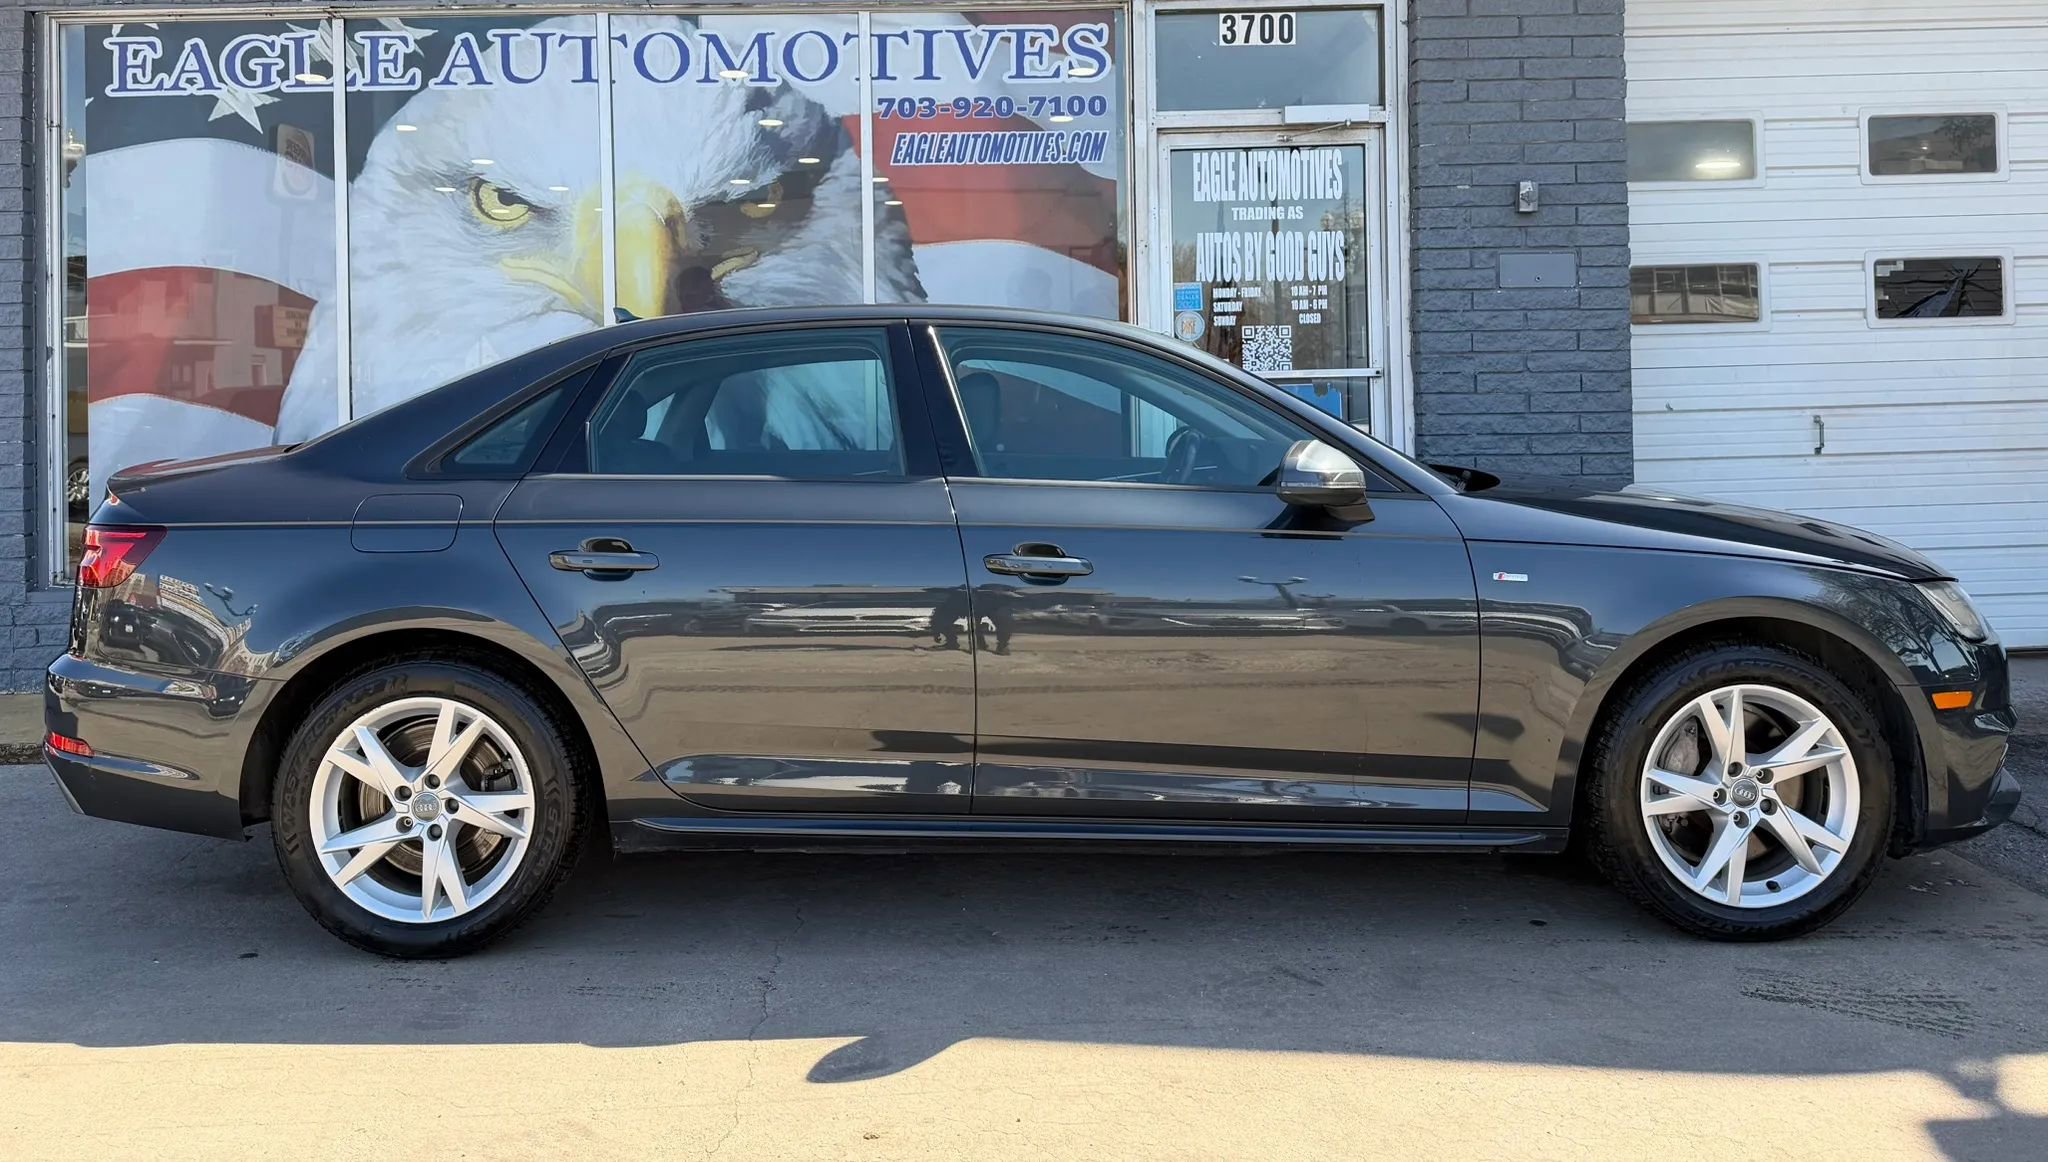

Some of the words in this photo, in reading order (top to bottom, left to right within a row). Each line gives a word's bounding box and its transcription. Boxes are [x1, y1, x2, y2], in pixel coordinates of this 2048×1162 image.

[1221, 13, 1294, 45] 3700
[106, 32, 420, 95] EAGLE
[431, 27, 1110, 87] AUTOMOTIVES
[877, 95, 1108, 119] 703-920-7100
[890, 130, 1108, 165] EAGLEAUTOMOTIVES.COM
[1192, 151, 1237, 202] EAGLE
[1238, 149, 1343, 202] AUTOMOTIVES
[1231, 206, 1285, 221] TRADING
[1287, 206, 1304, 220] AS
[1195, 231, 1242, 283] AUTOS
[1244, 231, 1263, 282] BY
[1265, 230, 1305, 282] GOOD
[1307, 230, 1345, 282] GUYS
[1212, 287, 1237, 299] MONDAY
[1241, 286, 1262, 298] FRIDAY
[1291, 285, 1299, 297] 10
[1299, 285, 1309, 296] AM
[1312, 285, 1317, 296] 7
[1317, 285, 1328, 296] PM
[1212, 301, 1243, 313] SATURDAY
[1291, 300, 1299, 311] 10
[1299, 299, 1309, 311] AM
[1318, 298, 1328, 310] PM
[1213, 315, 1237, 327] SUNDAY
[1298, 313, 1322, 325] CLOSED
